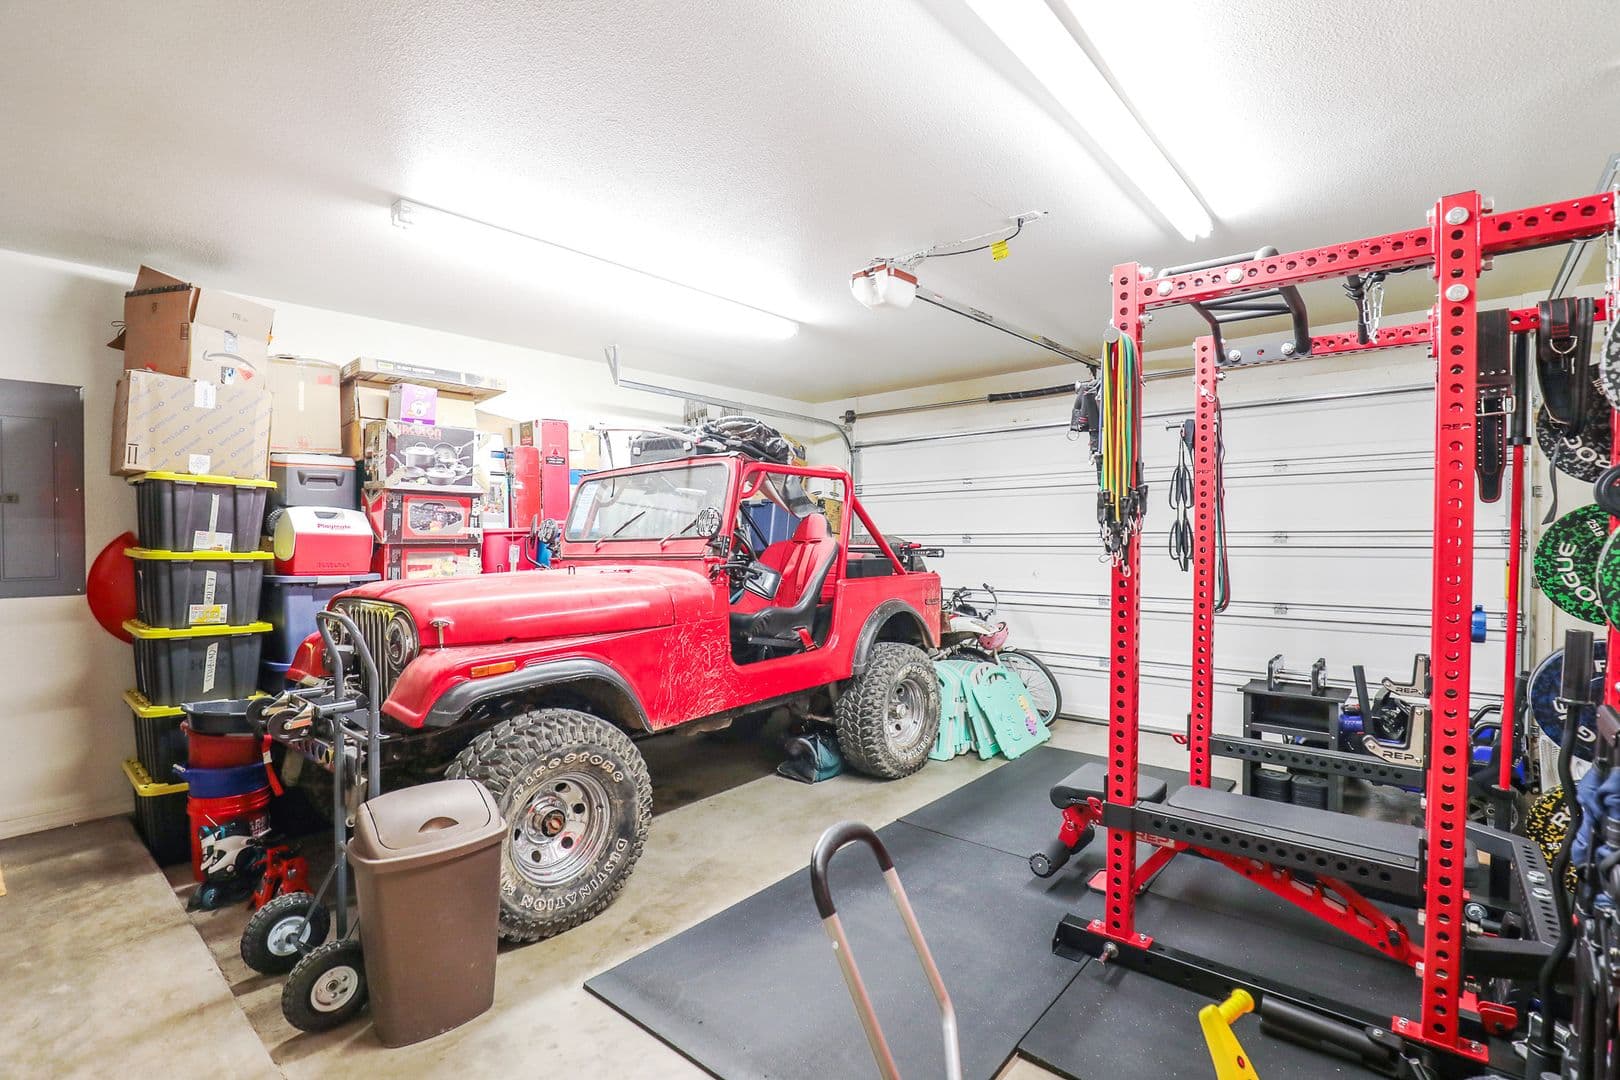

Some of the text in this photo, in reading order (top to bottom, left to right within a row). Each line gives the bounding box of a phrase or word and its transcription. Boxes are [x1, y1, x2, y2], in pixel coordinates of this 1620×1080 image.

[1441, 422, 1472, 431] REP
[1557, 542, 1603, 608] OGUE
[1395, 686, 1418, 694] REP
[1382, 749, 1415, 761] REP
[513, 751, 625, 802] Firestone
[520, 837, 629, 912] DESTINATION
